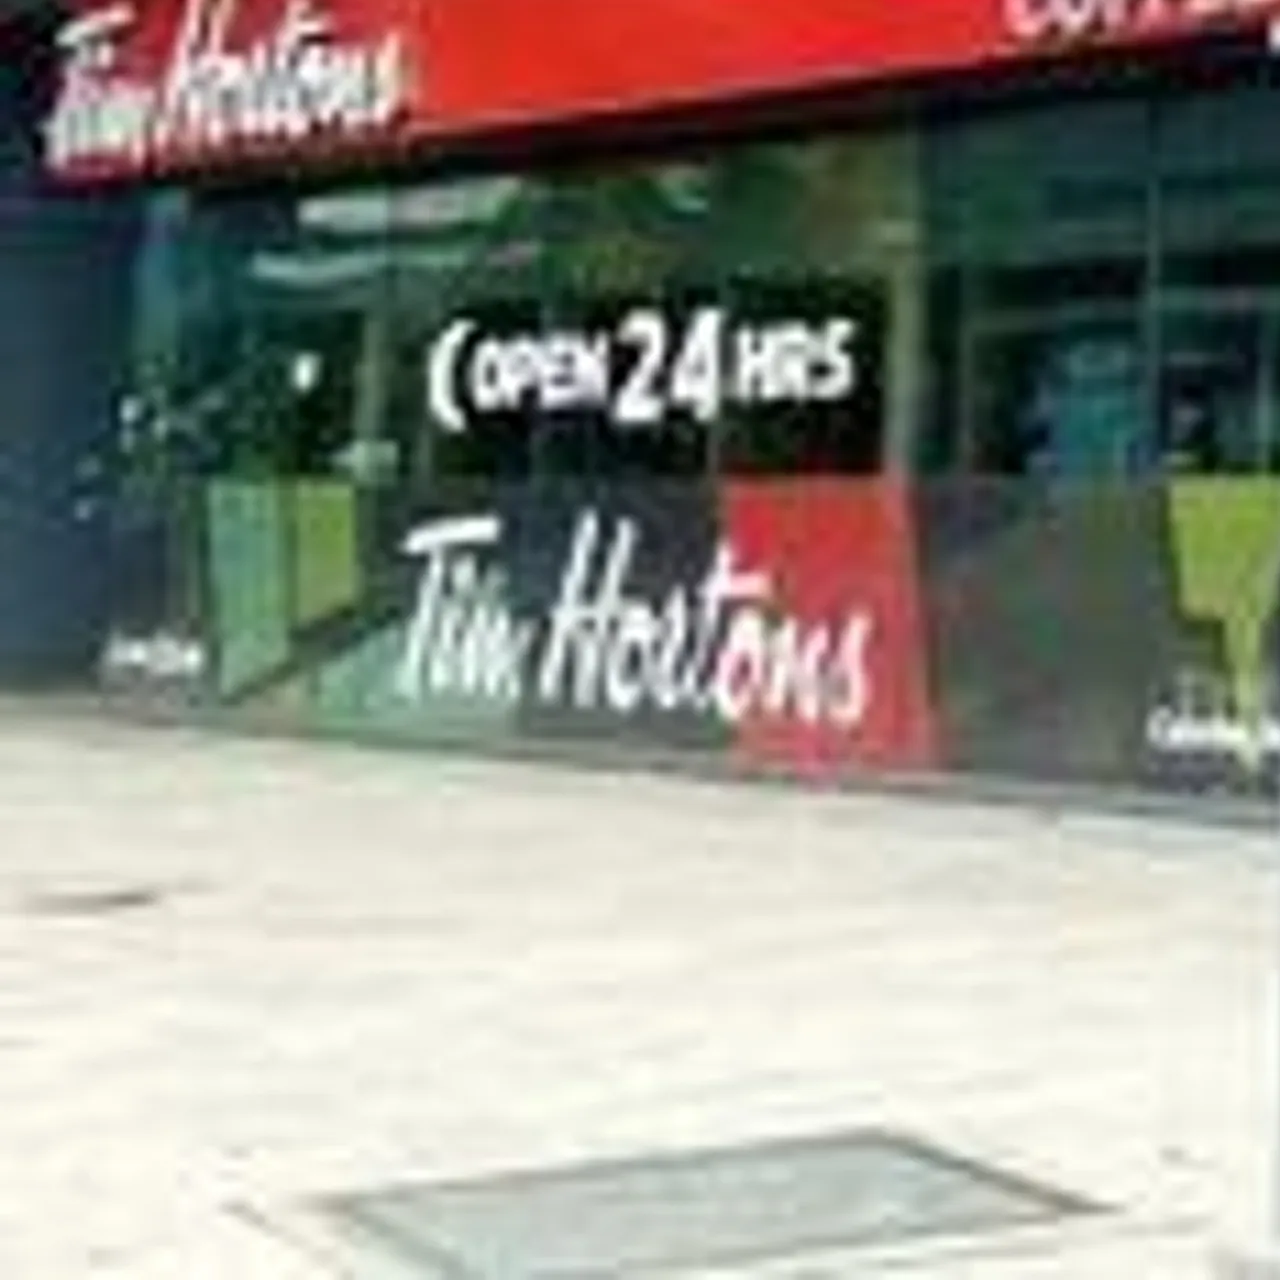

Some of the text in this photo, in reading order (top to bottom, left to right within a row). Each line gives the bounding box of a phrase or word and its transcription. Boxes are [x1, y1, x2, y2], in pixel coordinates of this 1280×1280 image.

[470, 307, 857, 422] OPEN 24 HRS
[398, 505, 873, 725] Tim Hortons
